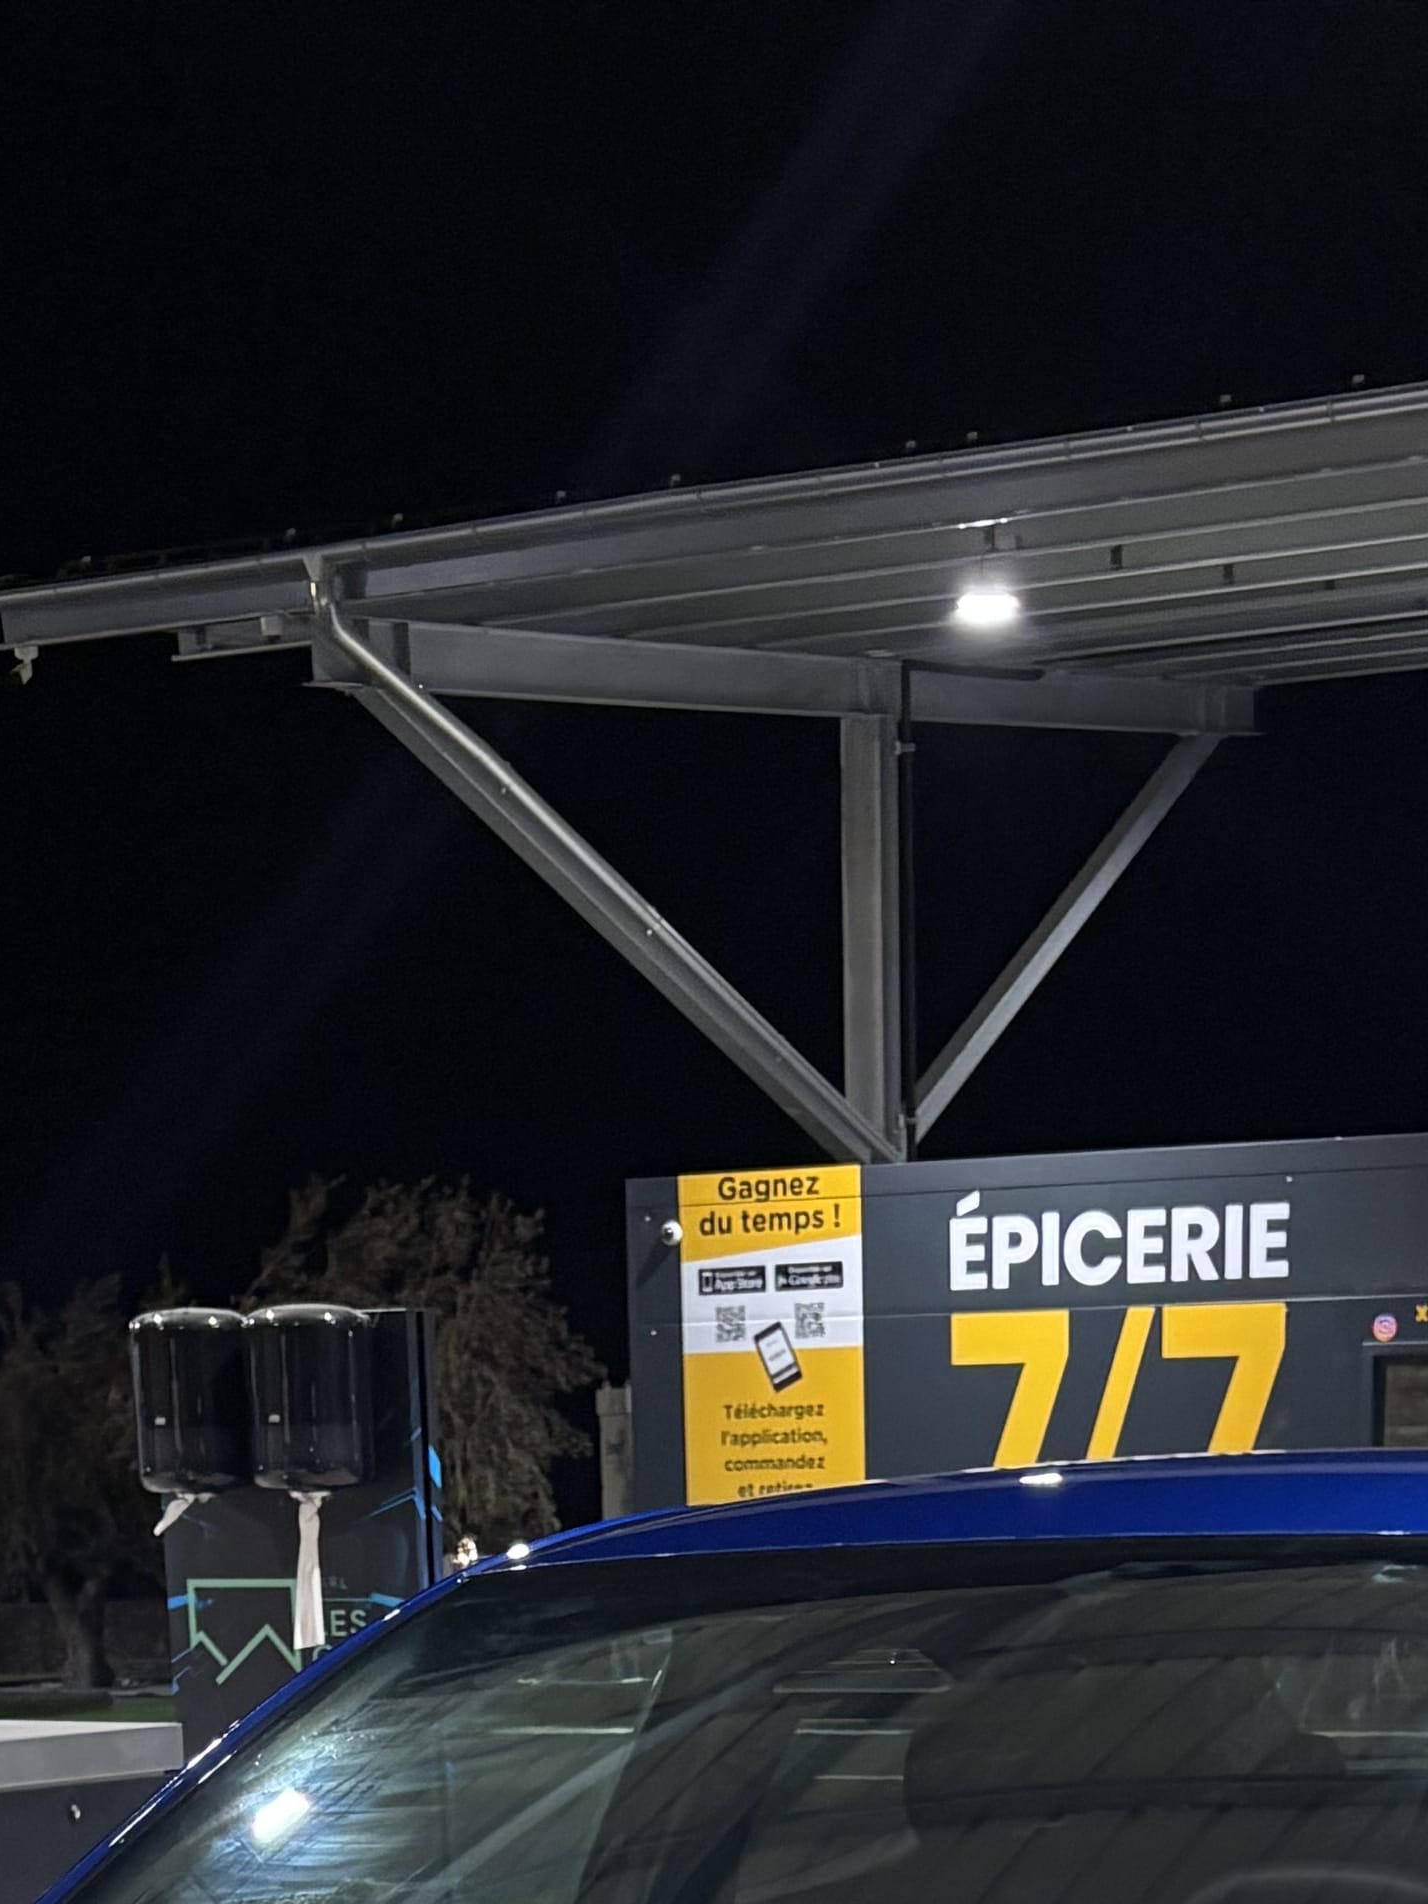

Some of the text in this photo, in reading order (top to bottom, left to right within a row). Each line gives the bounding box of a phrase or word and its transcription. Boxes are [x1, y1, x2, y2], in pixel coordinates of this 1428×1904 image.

[718, 1176, 820, 1203] Gagnez
[699, 1203, 841, 1236] du temps !
[950, 1190, 1290, 1291] ÉPICERIE
[950, 1302, 1287, 1471] 7/7
[724, 1401, 824, 1420] Téléchargez
[724, 1454, 825, 1472] commandez
[737, 1482, 754, 1498] et
[325, 1609, 367, 1637] ES
